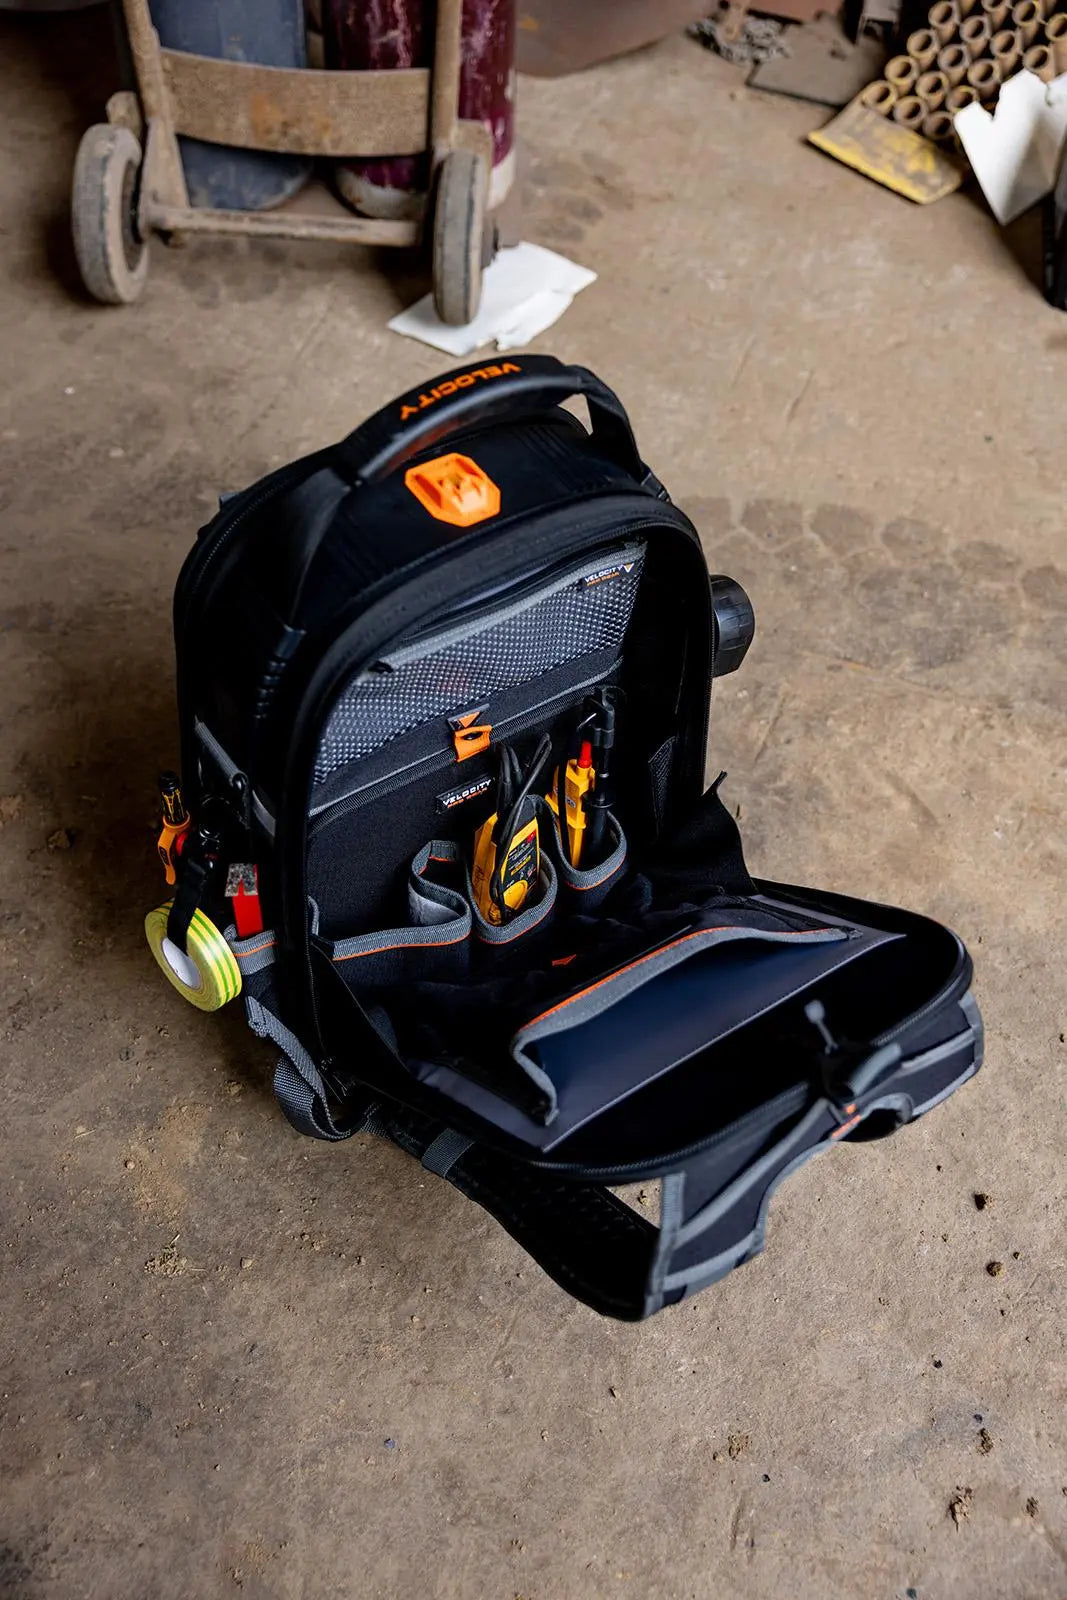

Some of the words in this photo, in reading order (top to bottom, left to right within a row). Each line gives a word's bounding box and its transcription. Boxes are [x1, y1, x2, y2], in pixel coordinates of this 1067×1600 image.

[400, 362, 522, 421] VELOCITY
[584, 564, 624, 583] VELOCITY
[442, 779, 491, 806] VELOCITY
